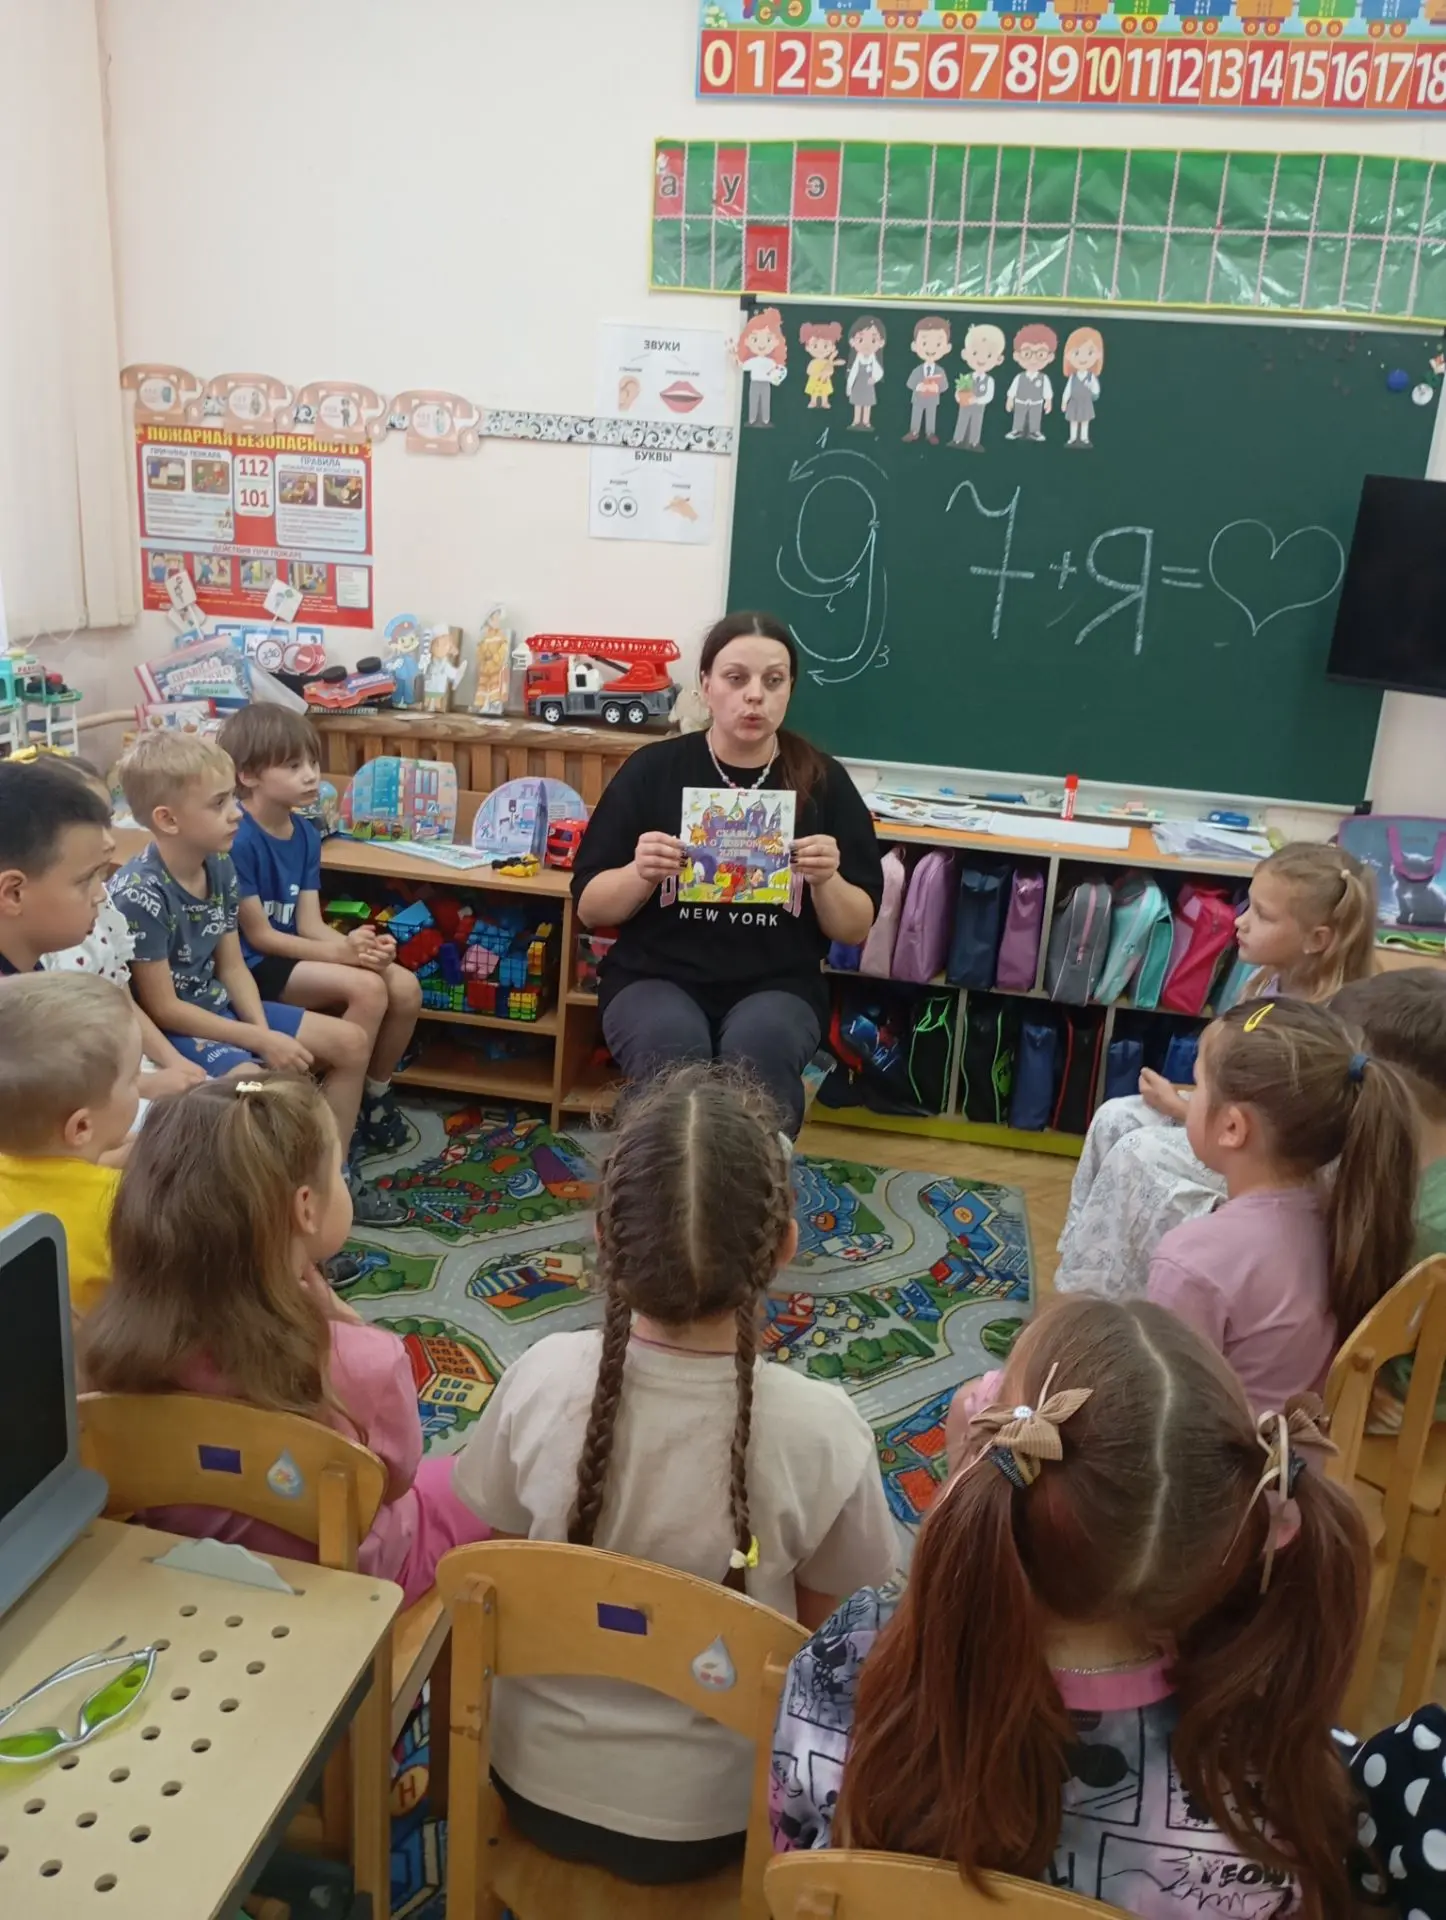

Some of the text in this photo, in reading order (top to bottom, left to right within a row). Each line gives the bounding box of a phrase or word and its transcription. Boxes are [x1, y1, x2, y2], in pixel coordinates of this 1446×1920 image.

[703, 39, 1446, 104] 0 1 2 3 4 5 6 7 8 9 10 11 12 13 14 15 16 17 18
[660, 173, 678, 197] а
[806, 175, 826, 199] э
[757, 248, 777, 272] и
[643, 339, 681, 352] ЗВУКИ
[634, 451, 673, 463] БУКВЫ
[239, 458, 269, 477] 112
[240, 488, 270, 508] 101
[679, 907, 779, 926] NEW YORK
